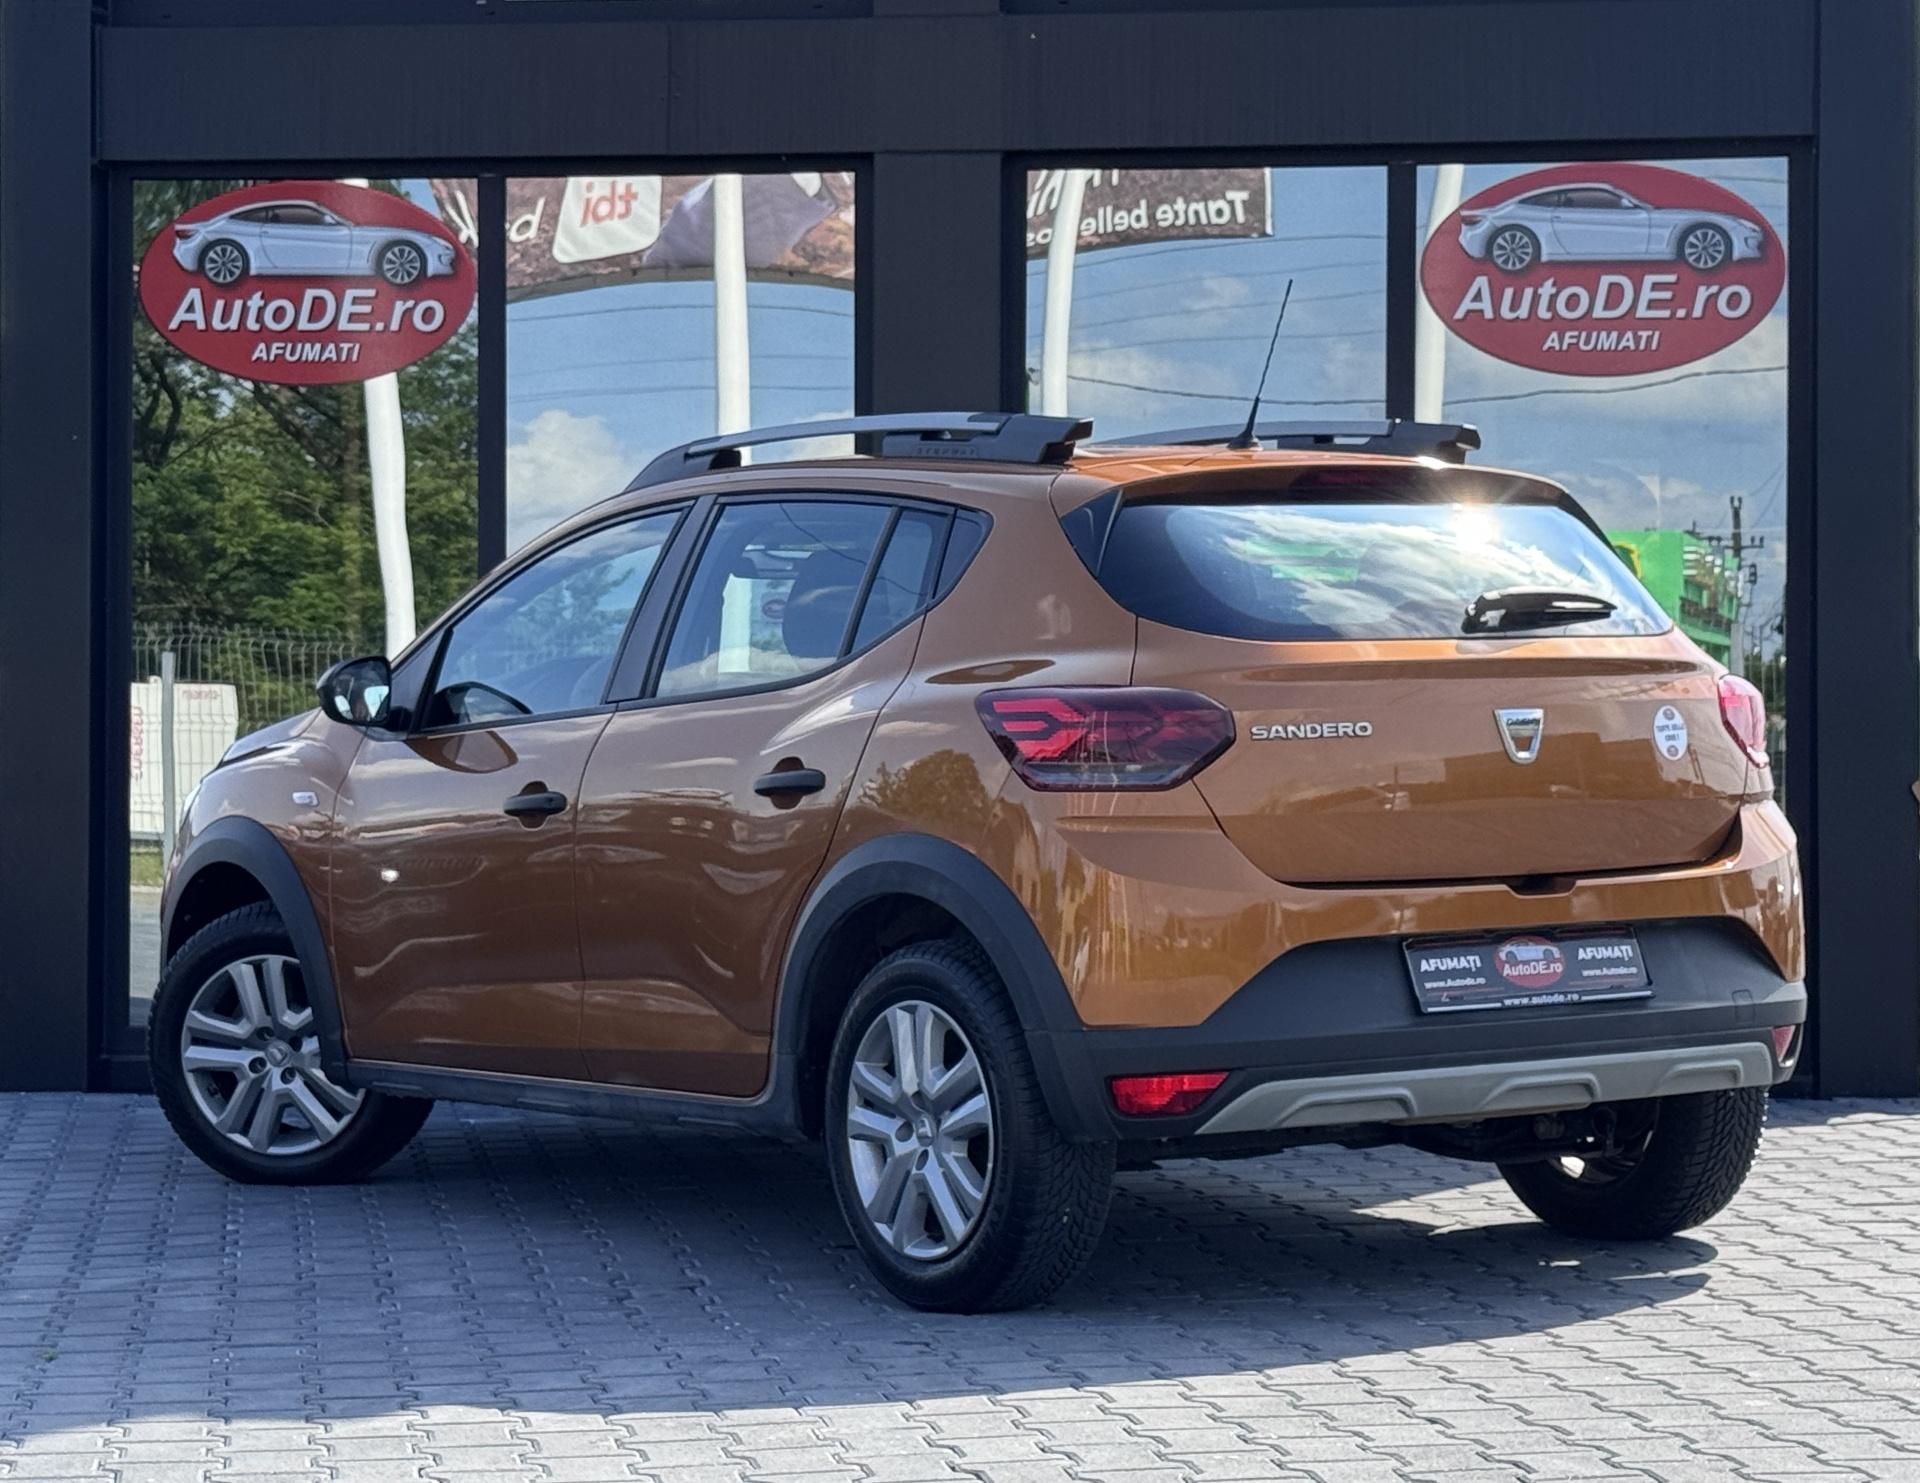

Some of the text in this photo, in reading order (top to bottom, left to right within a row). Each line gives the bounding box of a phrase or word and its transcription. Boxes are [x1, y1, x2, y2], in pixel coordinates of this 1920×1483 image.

[1452, 273, 1751, 321] AutoDE.ro
[169, 287, 446, 333] AutoDE.ro
[1542, 330, 1661, 352] AFUMATI
[251, 342, 361, 364] AFUMATI
[1250, 721, 1373, 740] SANDERO
[1502, 960, 1564, 977] AutoDE.ro
